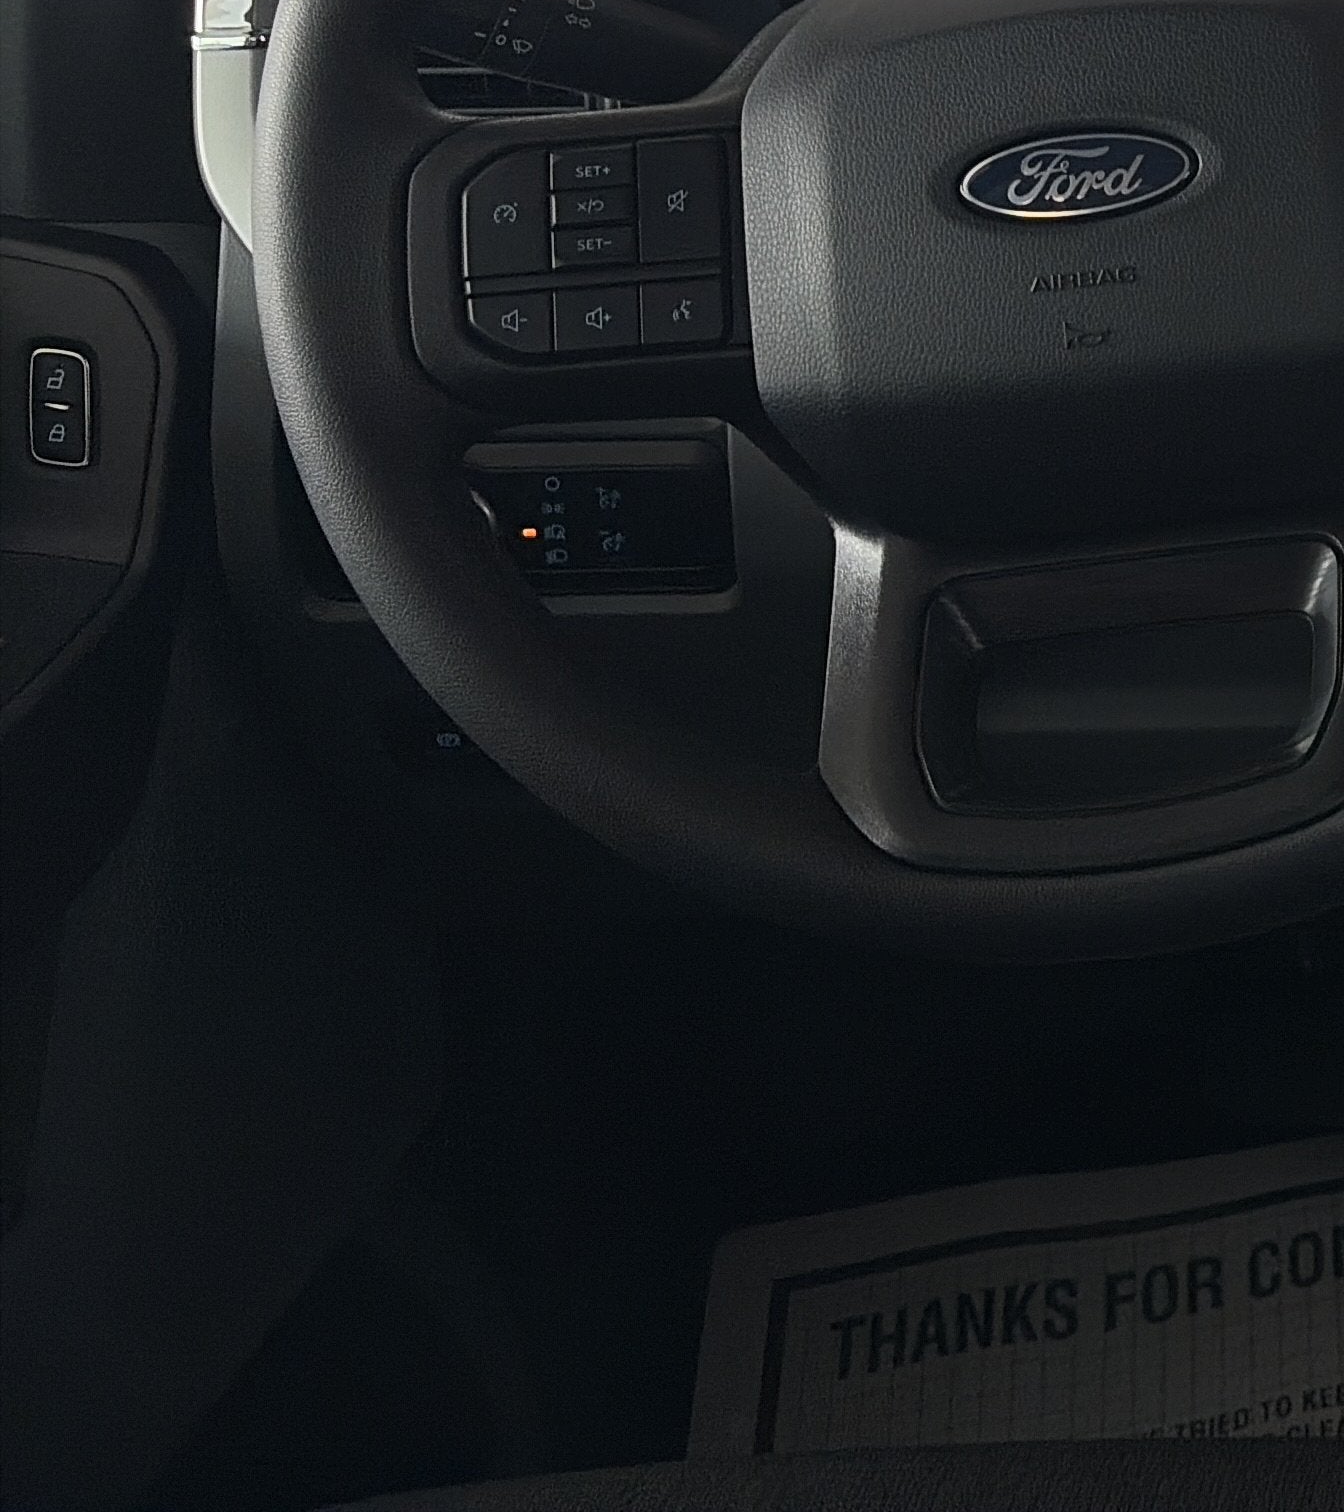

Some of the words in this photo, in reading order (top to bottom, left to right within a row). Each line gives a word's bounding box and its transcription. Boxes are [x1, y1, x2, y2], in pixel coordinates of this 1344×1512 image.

[1007, 145, 1145, 206] Ford
[830, 1282, 1079, 1382] THANKS
[1104, 1254, 1224, 1332] FOR
[1261, 1395, 1292, 1423] TO
